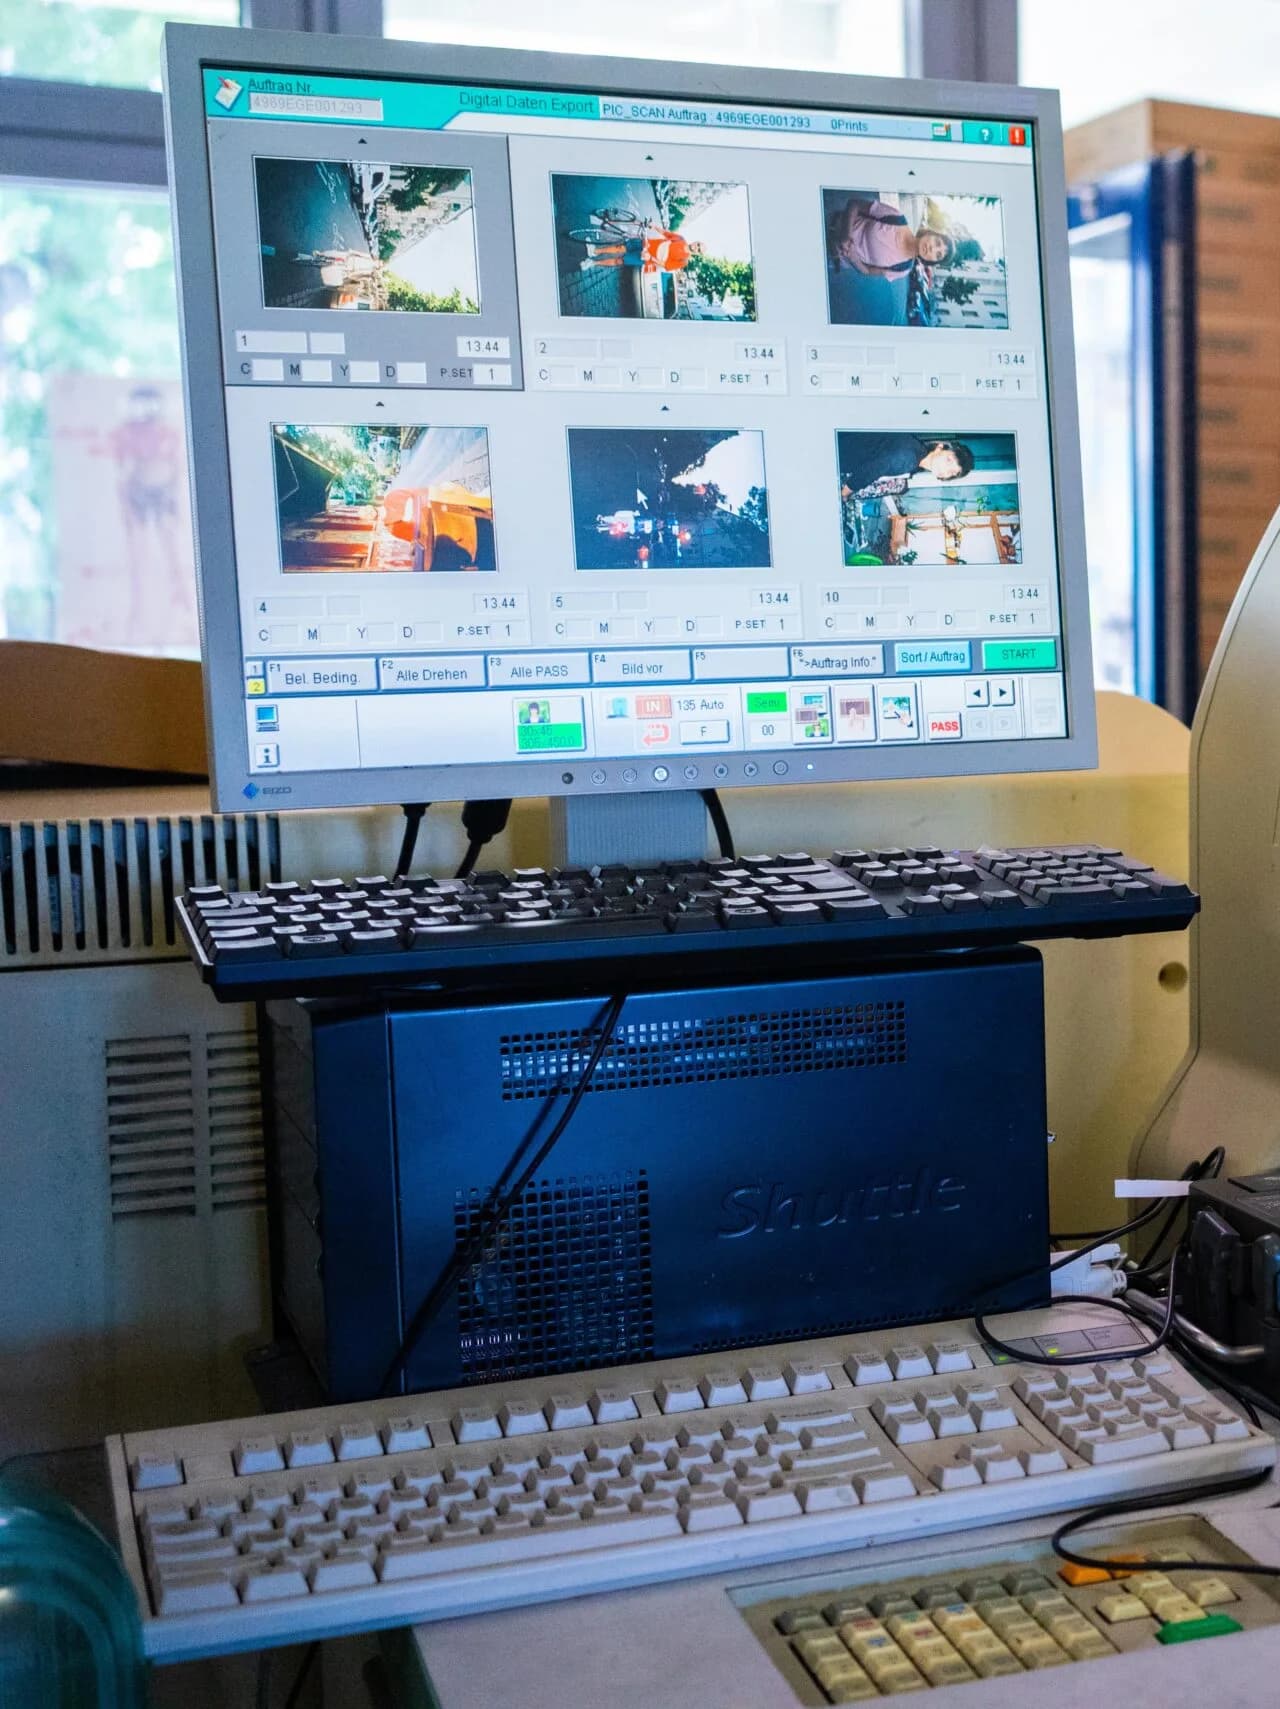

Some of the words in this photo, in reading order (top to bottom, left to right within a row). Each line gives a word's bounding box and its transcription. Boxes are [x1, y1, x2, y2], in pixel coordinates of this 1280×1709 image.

[459, 91, 501, 108] Digital
[506, 95, 548, 109] Daten
[552, 98, 595, 114] Export
[602, 104, 666, 119] PIC_SCAN
[668, 108, 707, 124] Auftrag
[241, 335, 248, 346] 1
[466, 340, 500, 352] 13.44
[539, 342, 548, 354] 2
[744, 348, 774, 359] 13.44
[810, 349, 818, 360] 3
[997, 354, 1026, 364] 13.44
[240, 362, 250, 375] C
[290, 364, 300, 376] M
[340, 365, 349, 376] Y
[386, 365, 396, 378] D
[538, 370, 548, 380] C
[583, 370, 593, 382] M
[628, 370, 637, 382] Y
[670, 372, 680, 383] D
[810, 374, 819, 386] C
[851, 376, 860, 386] M
[892, 376, 900, 388] Y
[930, 377, 939, 388] D
[759, 592, 789, 604] 13.44
[825, 592, 840, 602] 10
[1011, 588, 1038, 599] 13.44
[258, 602, 267, 612] 4
[483, 598, 516, 609] 13.44
[555, 596, 564, 608] 5
[825, 617, 834, 628] C
[866, 616, 875, 627] M
[906, 616, 914, 626] Y
[944, 614, 953, 625] D
[555, 623, 564, 635] C
[599, 622, 609, 633] M
[644, 621, 652, 632] Y
[686, 620, 695, 632] D
[258, 629, 270, 642] C
[307, 628, 318, 641] M
[357, 627, 366, 640] Y
[402, 626, 413, 638] D
[594, 654, 606, 664] F4
[695, 651, 706, 660] F5
[901, 651, 922, 663] Sort
[930, 650, 966, 665] Auftrag
[1001, 648, 1037, 660] START
[270, 663, 282, 672] F1
[382, 660, 394, 670] F2
[490, 657, 502, 666] F3
[396, 669, 421, 682] Alle
[422, 668, 468, 680] Drehen
[510, 666, 532, 678] Alle
[536, 665, 568, 678] PASS
[622, 663, 643, 675] Bild
[646, 664, 664, 674] vor
[313, 672, 361, 687] Beding.
[677, 700, 696, 712] 135
[700, 700, 724, 710] Auto
[931, 720, 960, 732] PASS
